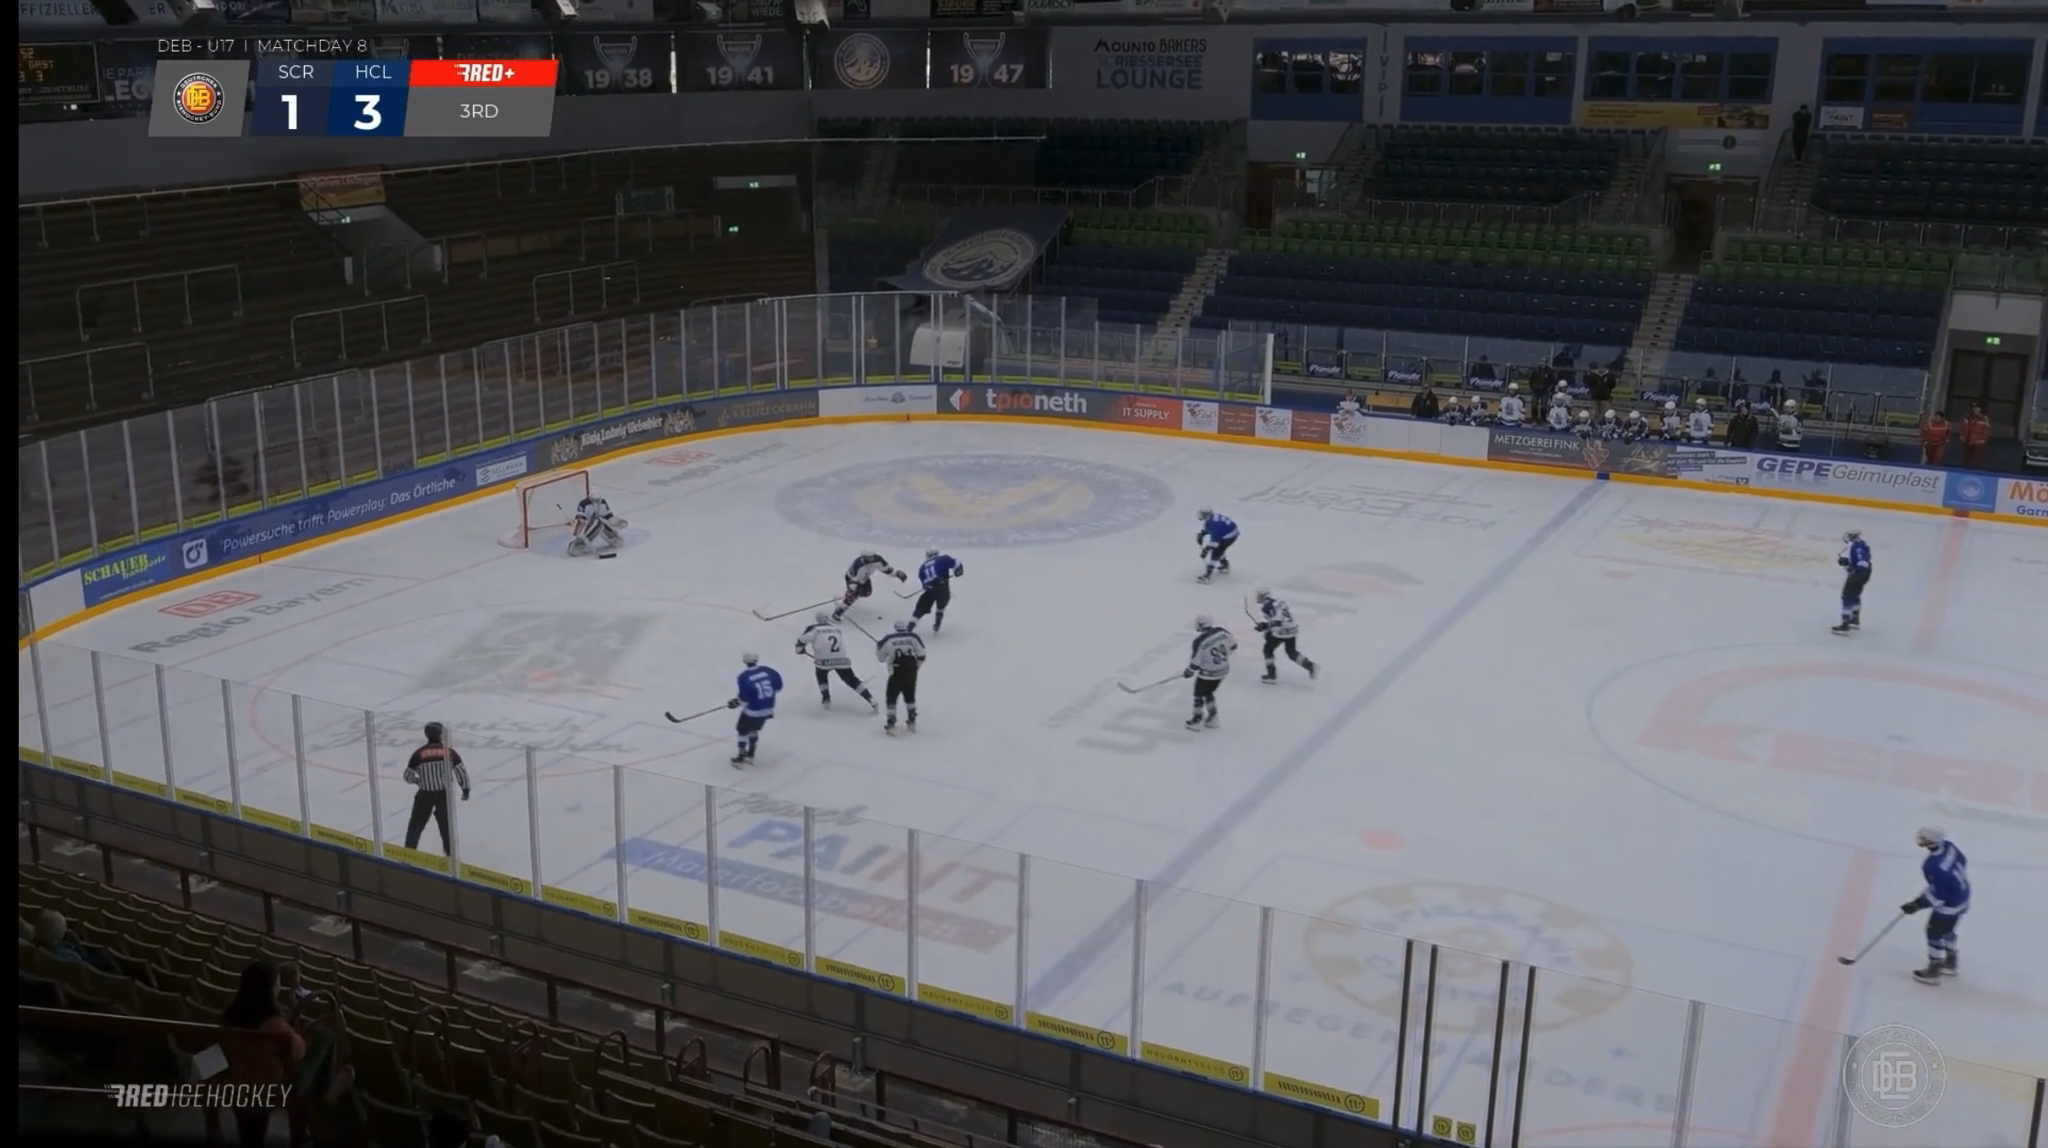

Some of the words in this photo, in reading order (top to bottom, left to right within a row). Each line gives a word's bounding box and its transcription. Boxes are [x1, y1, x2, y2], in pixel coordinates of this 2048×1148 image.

[1159, 38, 1207, 54] BAKERS
[1096, 68, 1203, 90] LOUNGE
[985, 388, 1088, 414] tproneth
[1123, 406, 1132, 418] IT
[1133, 407, 1170, 421] SUPPLY
[1494, 433, 1553, 448] METZGEREI
[1553, 440, 1580, 451] FINK
[1756, 457, 1833, 478] GEPE
[1832, 464, 1939, 490] Geimuplast
[222, 521, 296, 552] Powersuche
[298, 512, 325, 531] trifft
[390, 490, 411, 506] Das
[413, 475, 456, 499] Örtliche
[83, 553, 149, 586] SCHAUER
[827, 634, 840, 653] 2
[753, 680, 774, 701] 15
[727, 818, 1018, 903] PAINT
